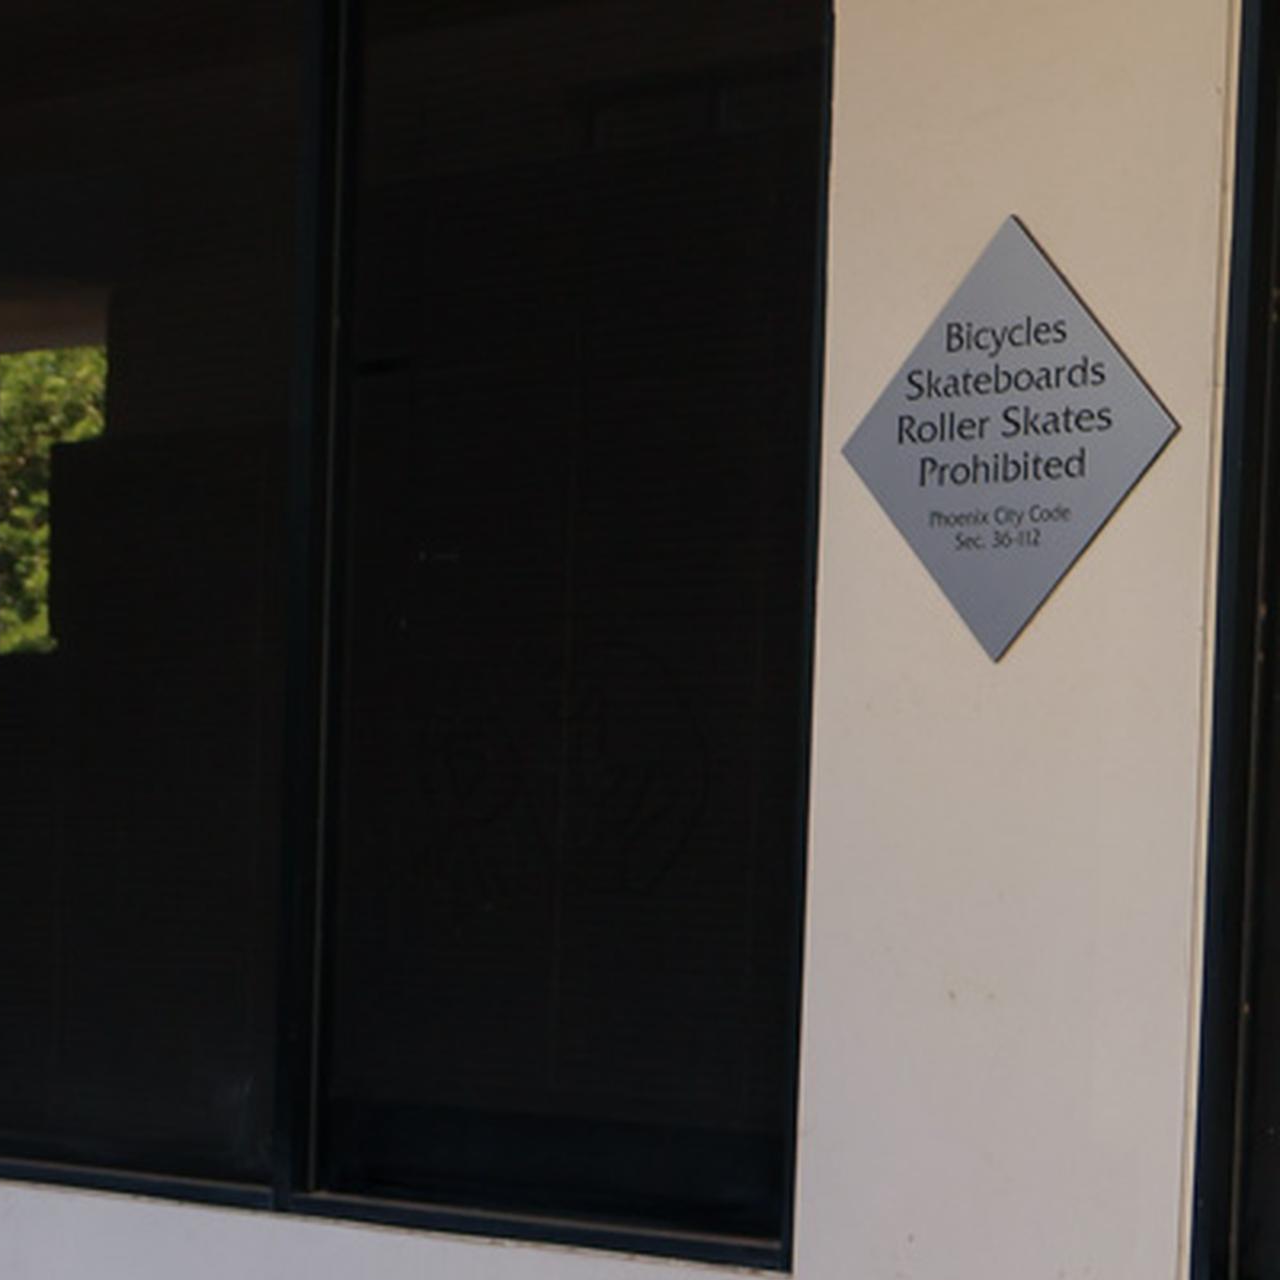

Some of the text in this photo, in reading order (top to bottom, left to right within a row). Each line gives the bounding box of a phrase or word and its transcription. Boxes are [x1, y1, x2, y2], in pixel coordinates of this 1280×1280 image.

[945, 315, 1068, 358] Bicycles
[905, 355, 1106, 401] Skateboards
[896, 405, 1113, 446] Roller Skates
[918, 447, 1087, 488] Prohibited
[929, 502, 1072, 528] Phoenix City Code
[954, 528, 1041, 550] Sec. 36-112
